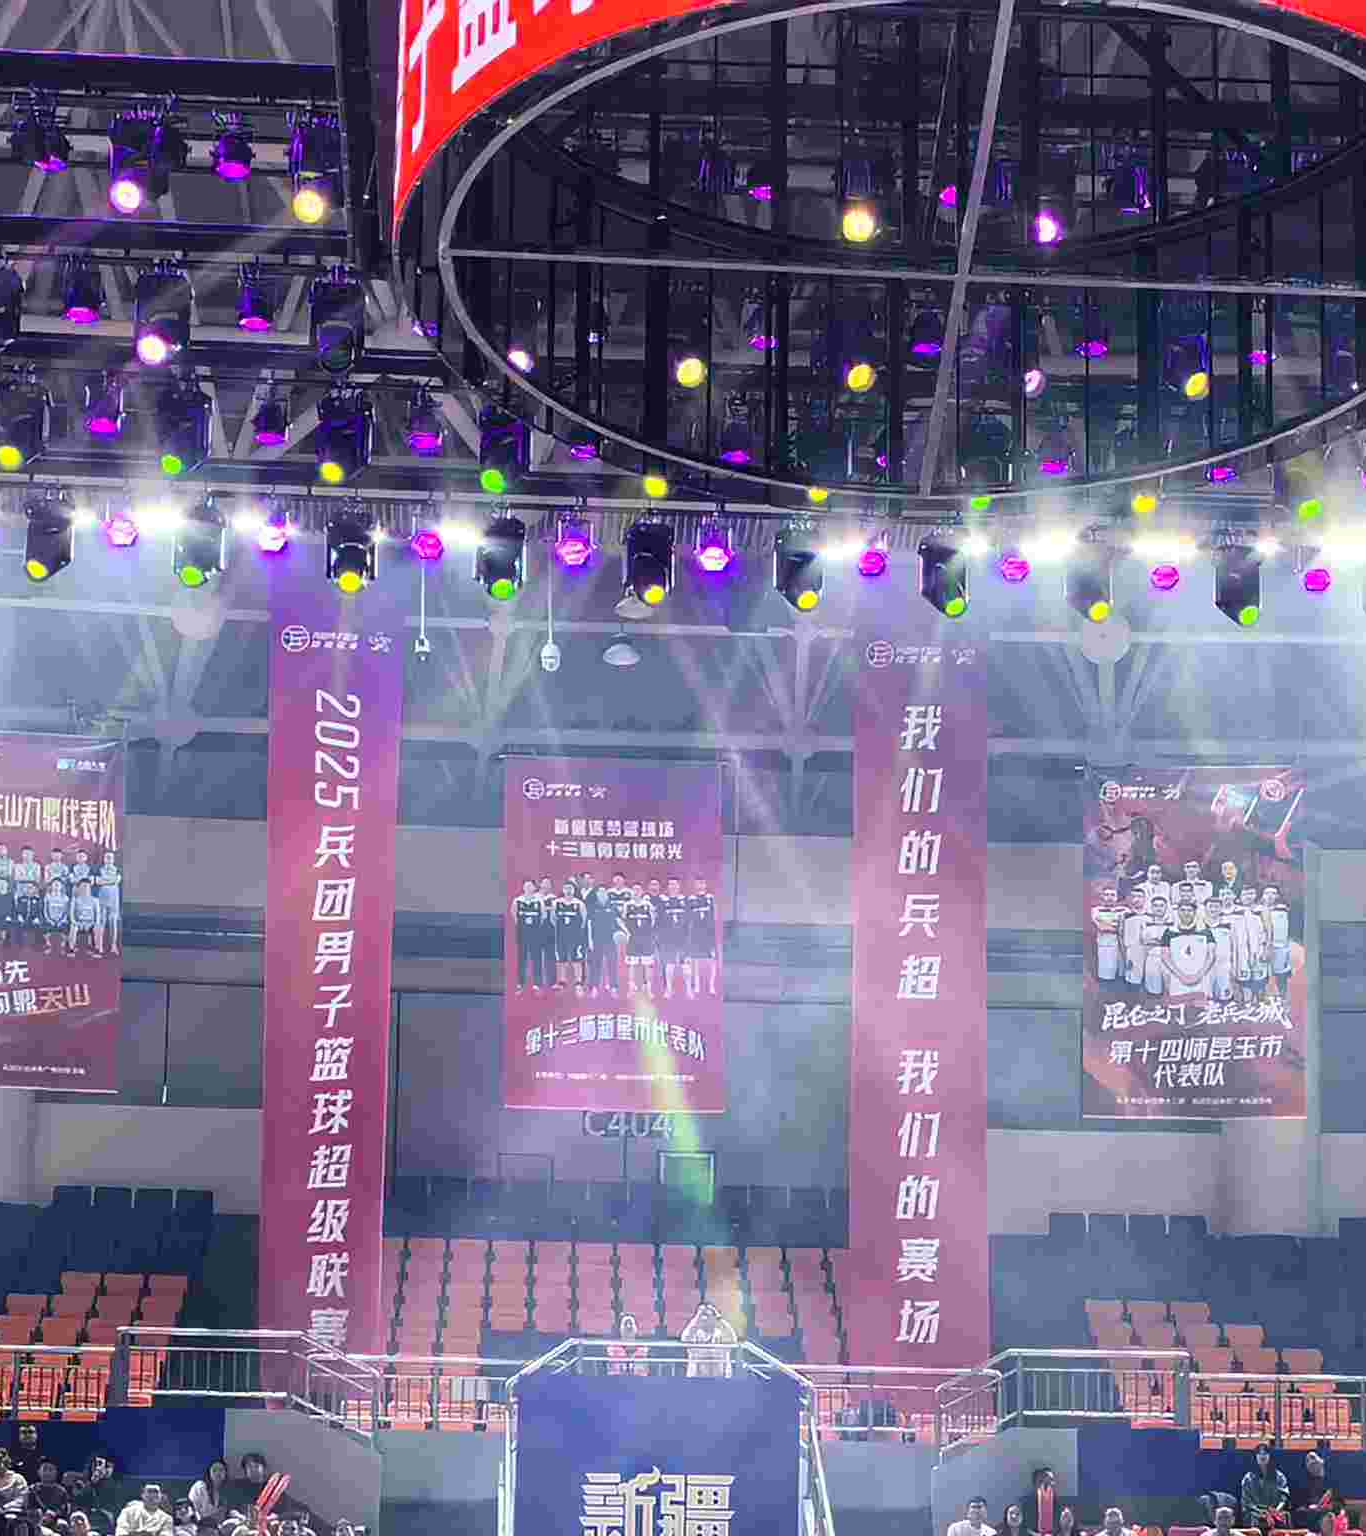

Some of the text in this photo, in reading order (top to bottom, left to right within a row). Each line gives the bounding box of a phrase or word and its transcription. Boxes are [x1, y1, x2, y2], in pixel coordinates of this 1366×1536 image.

[897, 704, 943, 1000] 我们的兵超
[307, 689, 361, 1359] 2025兵团男子篮球超级联赛
[1153, 1063, 1226, 1088] 代表队
[895, 1049, 941, 1344] 我们的赛场
